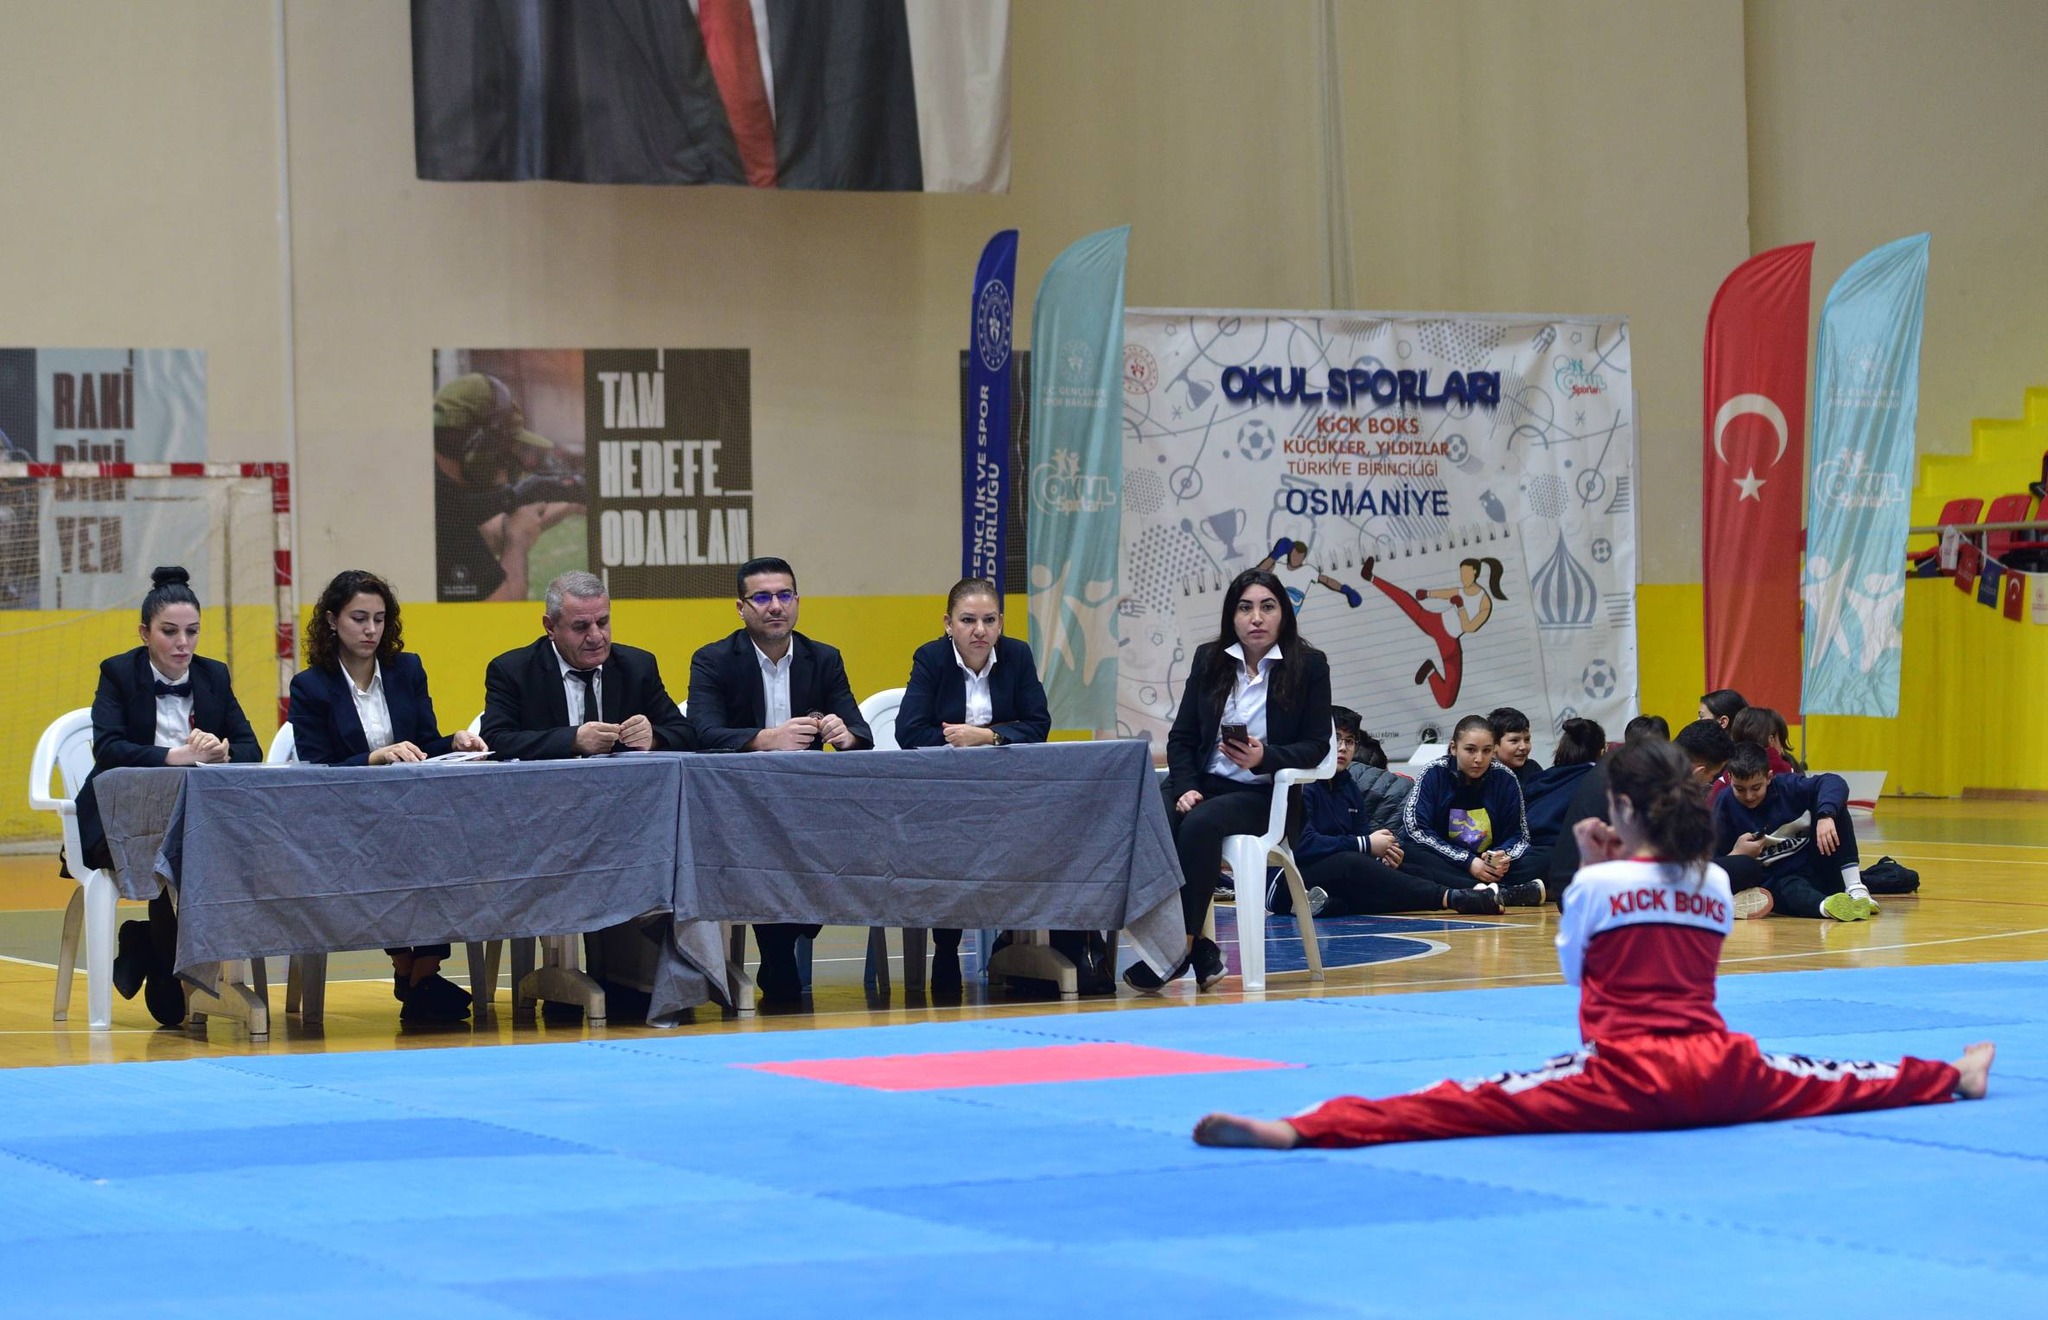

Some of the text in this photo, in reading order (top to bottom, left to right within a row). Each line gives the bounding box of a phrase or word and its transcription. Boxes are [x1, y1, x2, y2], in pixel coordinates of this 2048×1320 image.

[597, 371, 665, 429] TAM
[1220, 366, 1500, 407] OKUL SPORLARI
[978, 385, 990, 447] SPOR
[1368, 417, 1420, 435] BOKS
[1376, 439, 1450, 456] YILDIZLAR
[976, 452, 987, 482] VE
[1287, 458, 1353, 476] TÜRKİYE
[1286, 483, 1450, 517] OSMANİYE
[600, 508, 750, 567] ODAKLAN
[1609, 885, 1726, 924] KICK BOKS
